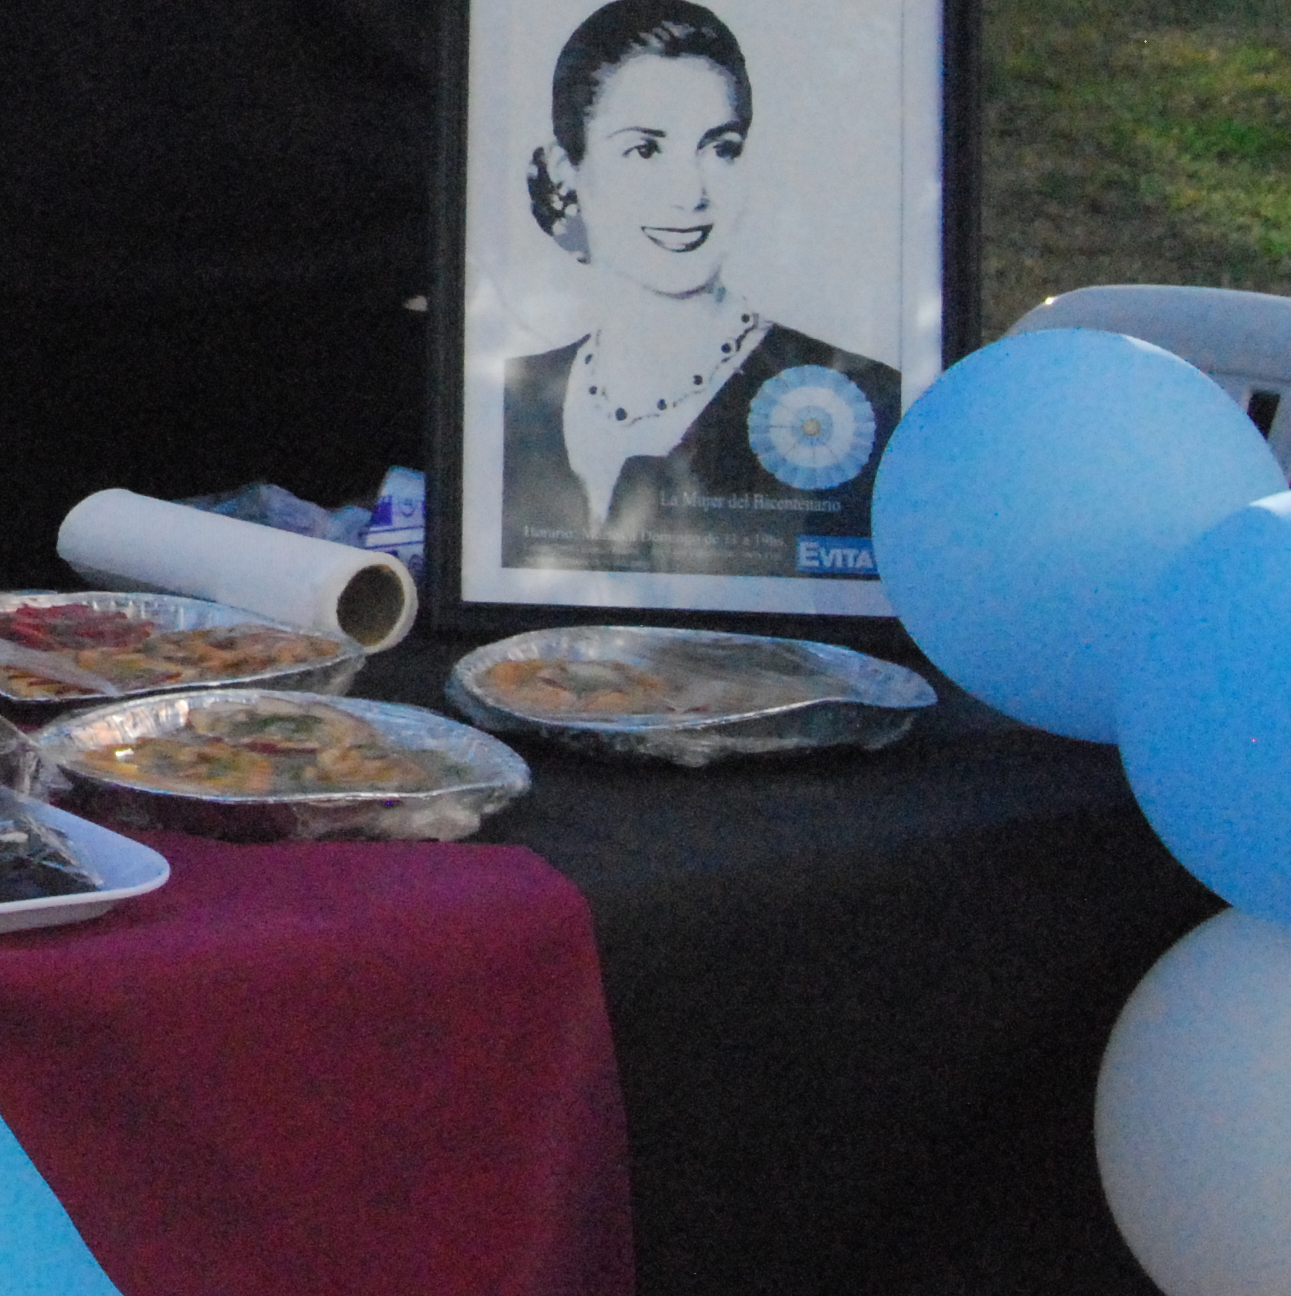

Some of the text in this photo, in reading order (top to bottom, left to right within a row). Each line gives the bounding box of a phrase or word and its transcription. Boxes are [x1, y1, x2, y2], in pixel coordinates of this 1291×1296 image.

[660, 491, 842, 512] La Mujer del Bicentenario
[799, 541, 874, 568] EVITA
